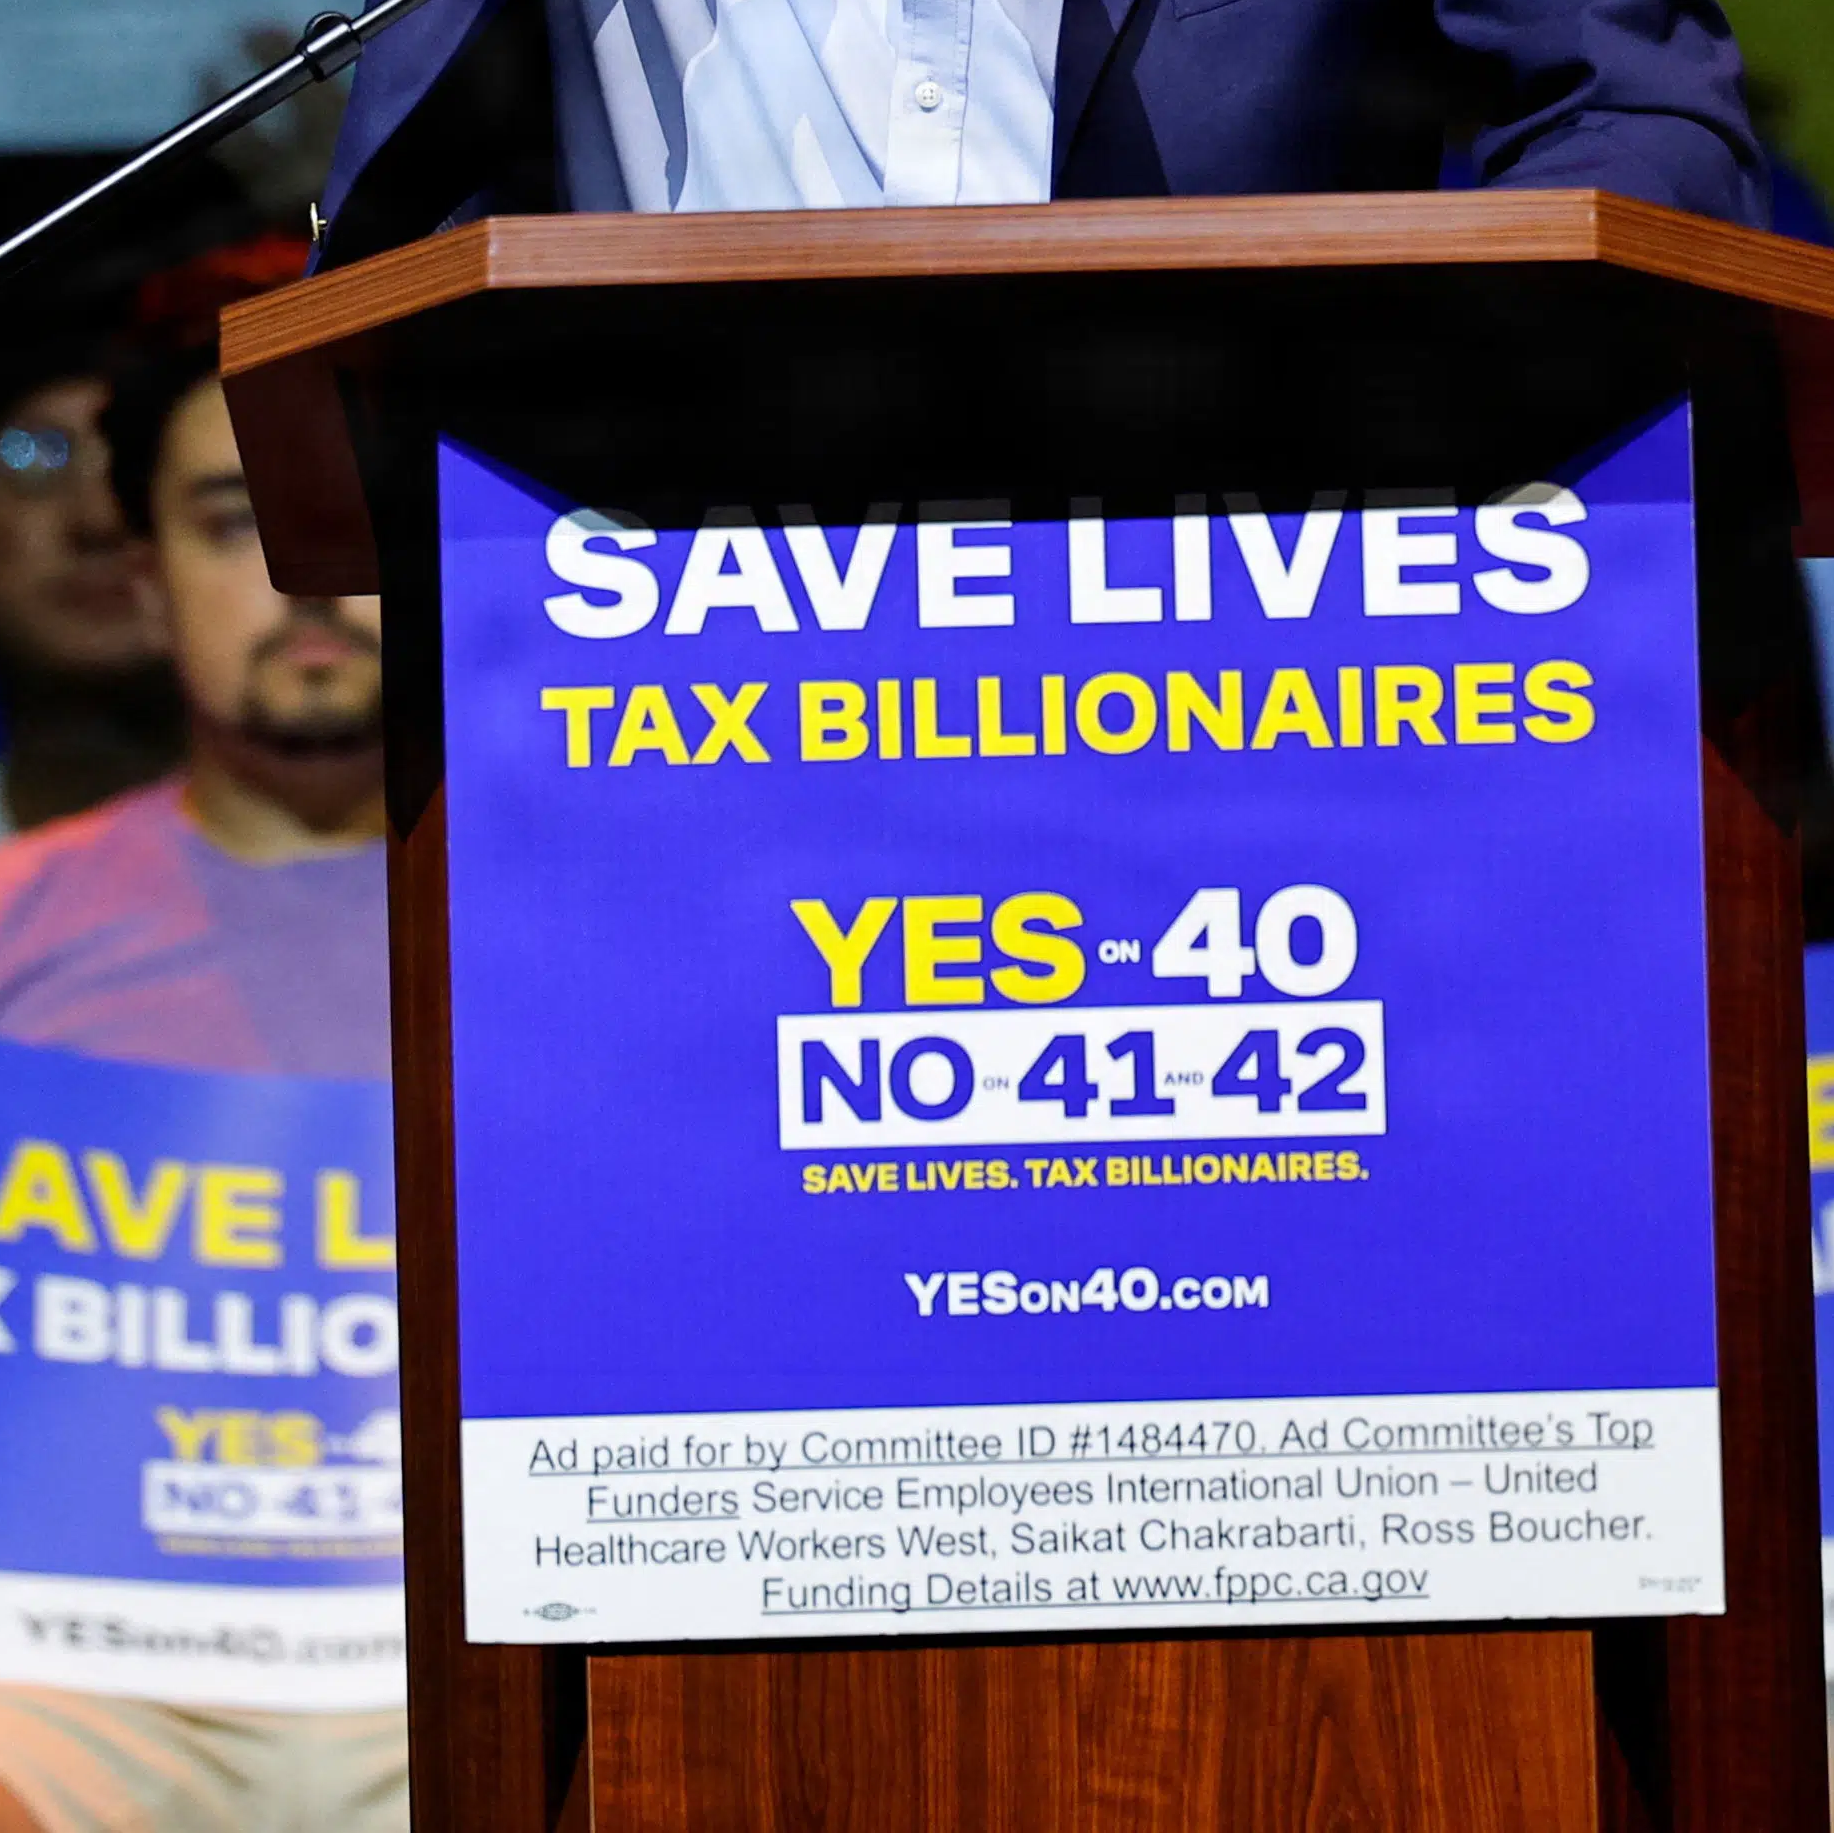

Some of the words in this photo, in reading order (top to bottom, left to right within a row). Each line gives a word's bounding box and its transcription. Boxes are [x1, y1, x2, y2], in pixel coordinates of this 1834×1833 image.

[543, 496, 1016, 638] SAVE
[1067, 483, 1590, 626] LIVES
[541, 682, 772, 768] TAX
[800, 660, 1597, 762] BILLIONAIRES
[790, 891, 1086, 1008] YES
[1098, 938, 1141, 963] ON
[1151, 883, 1359, 998] 40
[801, 1034, 975, 1124] NO
[983, 1076, 1010, 1091] ON
[1017, 1029, 1173, 1119] 41
[1164, 1069, 1205, 1086] AND
[1209, 1025, 1369, 1113] 42
[802, 1163, 899, 1195] SAVE
[907, 1160, 1019, 1191] LIVES.
[1025, 1157, 1100, 1188] TAX
[1106, 1150, 1370, 1186] BILLIONAIRES.
[156, 1405, 325, 1468] YES
[530, 1439, 577, 1470] Ad
[593, 1438, 669, 1475] paid
[684, 1435, 731, 1467] for
[745, 1433, 786, 1471] by
[801, 1428, 1002, 1465] Committee
[1018, 1426, 1056, 1458] ID
[1070, 1421, 1266, 1457] #1484470.
[1280, 1419, 1329, 1452] Ad
[1343, 1414, 1574, 1449] Committee's
[1588, 1412, 1655, 1450] Top
[164, 1479, 261, 1522] NO
[279, 1481, 361, 1523] 41
[587, 1484, 739, 1518] Funders
[752, 1480, 884, 1513] Service
[897, 1475, 1094, 1515] Employees
[1107, 1467, 1323, 1504] International
[1336, 1465, 1438, 1498] Union
[1485, 1462, 1598, 1495] United
[534, 1533, 727, 1567] Healthcare
[738, 1529, 886, 1561] Workers
[898, 1525, 998, 1560] West,
[1011, 1521, 1125, 1554] Saikat
[1140, 1516, 1366, 1552] Chakrabarti,
[1382, 1512, 1474, 1545] Ross
[1490, 1507, 1654, 1543] Boucher.
[763, 1577, 912, 1612] Funding
[927, 1571, 1053, 1605] Details
[1067, 1577, 1099, 1601] at
[1113, 1566, 1430, 1604] www.fppc.ca.gov
